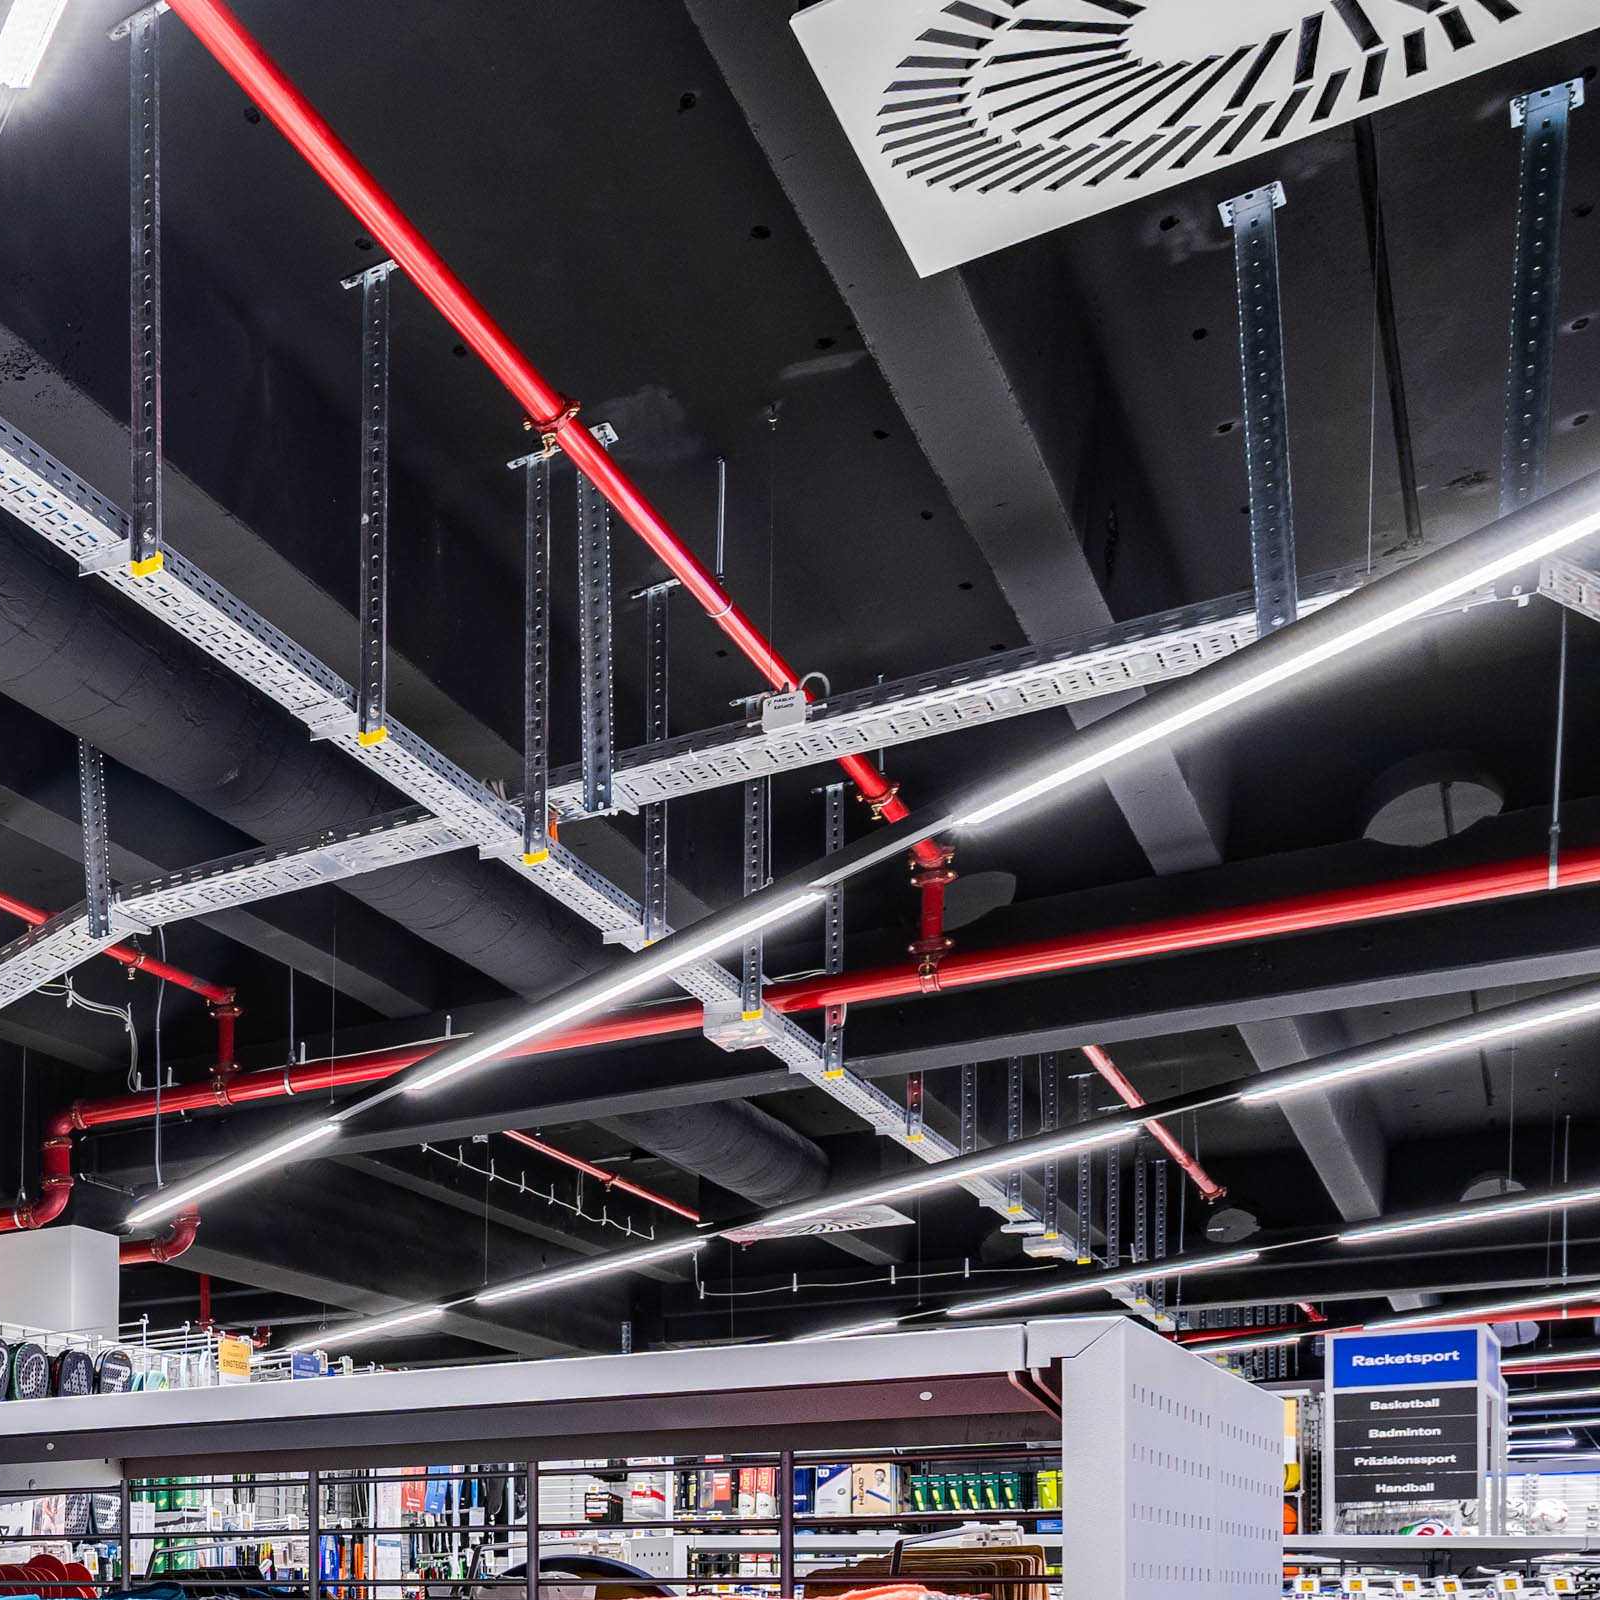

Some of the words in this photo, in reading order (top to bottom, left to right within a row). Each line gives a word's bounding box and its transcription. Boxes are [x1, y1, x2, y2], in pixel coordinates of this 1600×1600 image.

[1352, 1350, 1460, 1367] Racketsport
[1370, 1398, 1440, 1411] Basketball
[1368, 1428, 1441, 1439] Badminton
[1354, 1454, 1457, 1467] Präzisionssport
[1375, 1482, 1435, 1494] Handball
